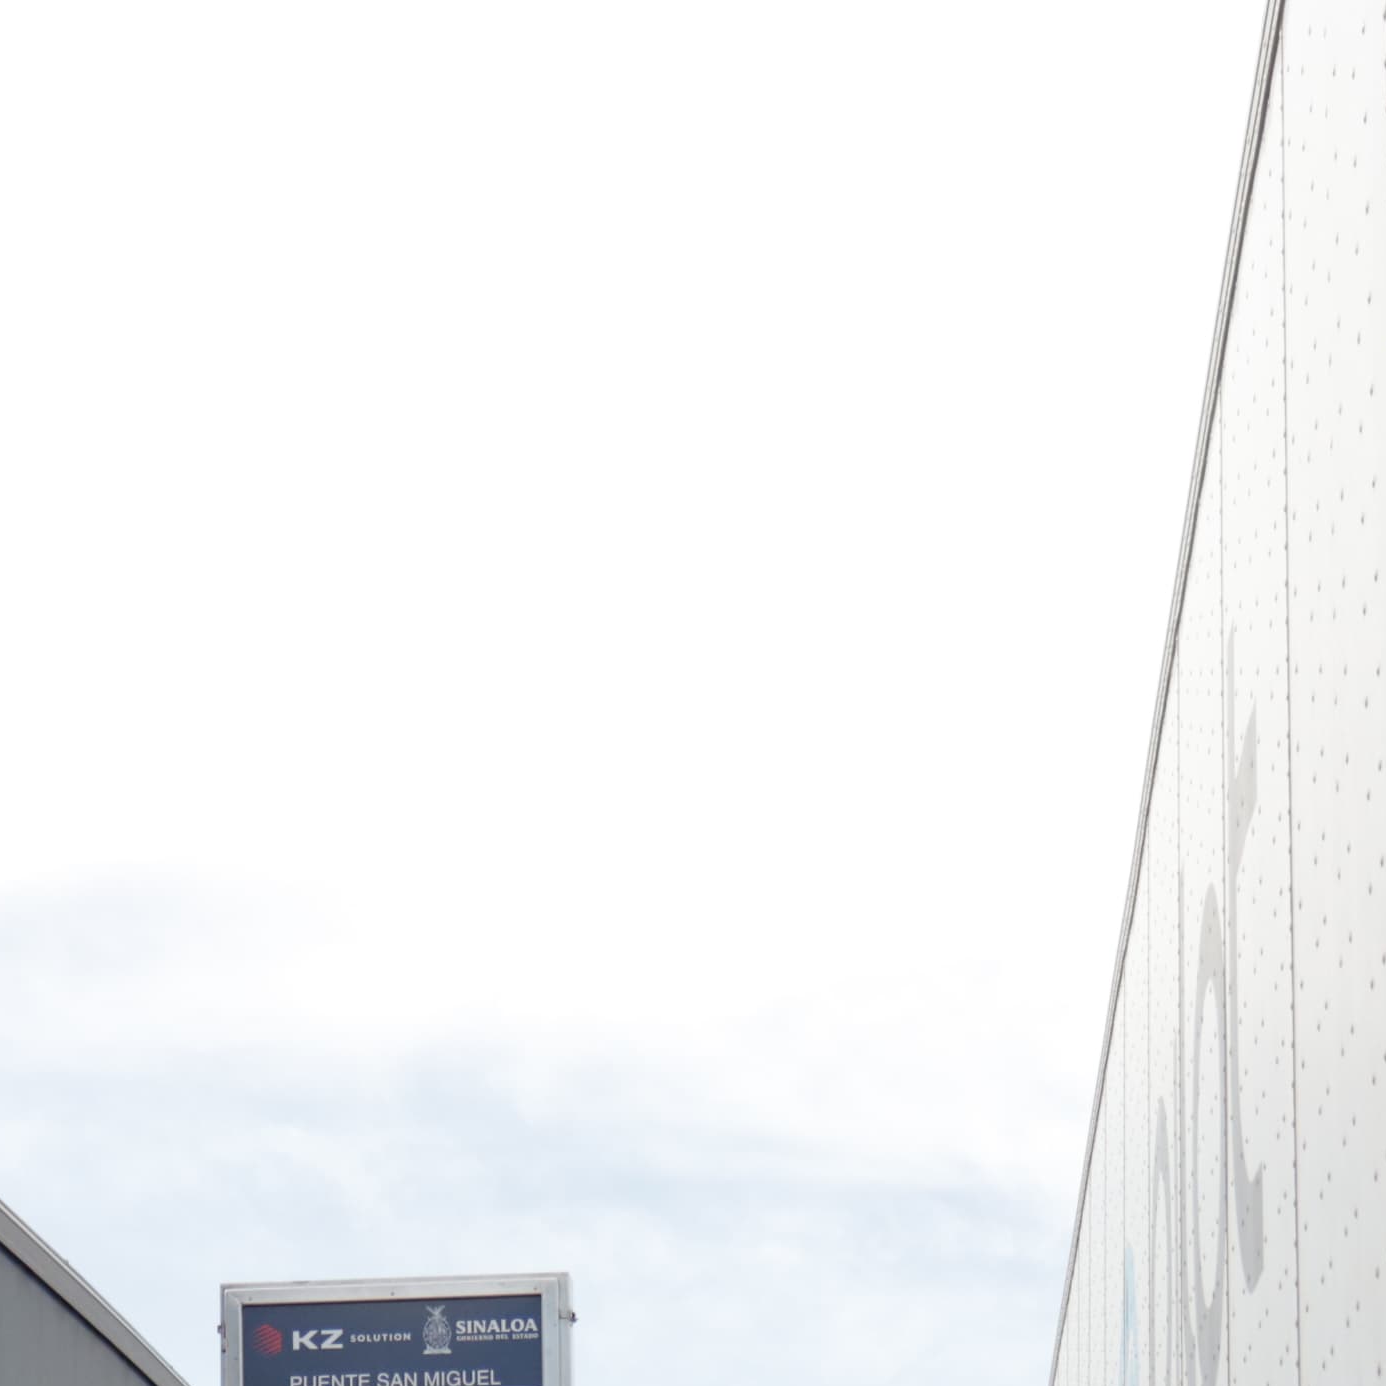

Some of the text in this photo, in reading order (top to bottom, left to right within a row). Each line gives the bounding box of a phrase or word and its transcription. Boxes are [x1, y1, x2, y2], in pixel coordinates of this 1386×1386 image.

[455, 1318, 538, 1335] SINALOA
[292, 1329, 411, 1351] KZ SOLUTION
[424, 1370, 501, 1386] MIGUEL
